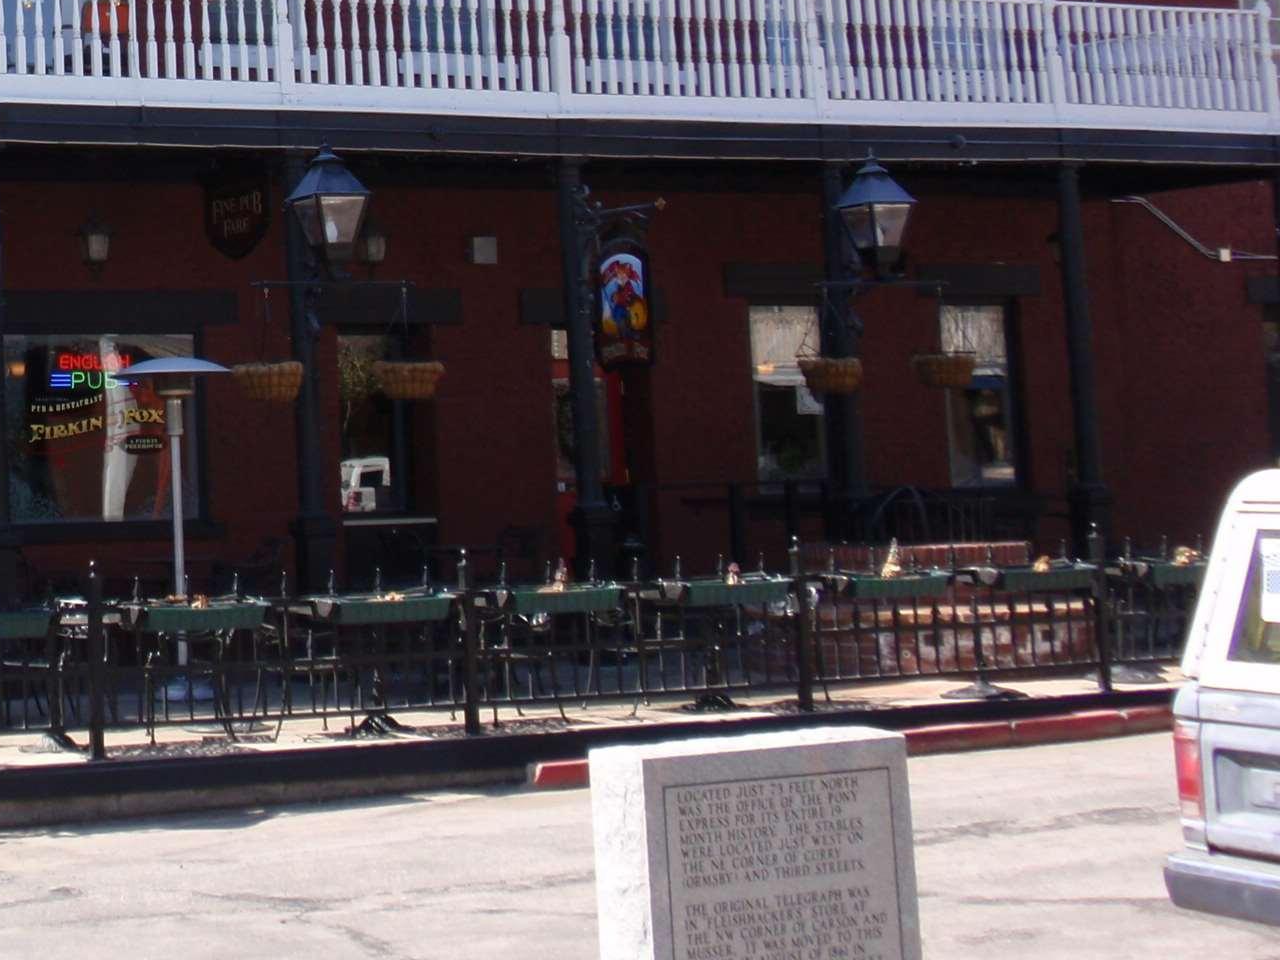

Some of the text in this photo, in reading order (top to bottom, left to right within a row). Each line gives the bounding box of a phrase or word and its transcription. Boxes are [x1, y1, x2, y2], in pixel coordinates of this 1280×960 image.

[58, 354, 131, 369] ENGLISH
[72, 371, 119, 389] PUB
[29, 408, 166, 443] FIRKIN FOX
[677, 787, 730, 804] LOCATED
[736, 784, 764, 798] JUST
[789, 780, 815, 793] FEET
[821, 776, 858, 790] NORTH
[678, 791, 858, 817] WAS THE OFFICE OF THE PONY
[679, 815, 730, 832] EXPRESS
[735, 813, 755, 825] FOR
[761, 812, 779, 824] ITS
[785, 806, 824, 822] ENTIRE
[680, 830, 723, 845] MONTH
[788, 822, 810, 835] THE
[815, 817, 864, 833] STABLES
[681, 831, 864, 859] WERE LOCATED JUST WEST ON
[682, 860, 704, 874] THE
[732, 853, 778, 869] CORNER
[784, 852, 797, 864] OF
[803, 847, 841, 862] CURRY
[745, 869, 770, 882] AND
[775, 865, 811, 879] THIRD
[684, 919, 698, 930] IN
[812, 902, 847, 918] STORE
[854, 900, 866, 912] AT
[685, 887, 870, 917] THE ORIGINAL TELEGRAPH WAS
[687, 931, 711, 945] THE
[740, 923, 786, 940] CORNER
[792, 921, 805, 933] OF
[812, 915, 858, 932] CARSON
[864, 912, 888, 924] AND
[745, 941, 757, 954] IT
[763, 937, 786, 950] WAS
[792, 934, 831, 948] MOVED
[838, 929, 852, 944] TO
[857, 927, 883, 940] THIS
[854, 944, 865, 955] IN
